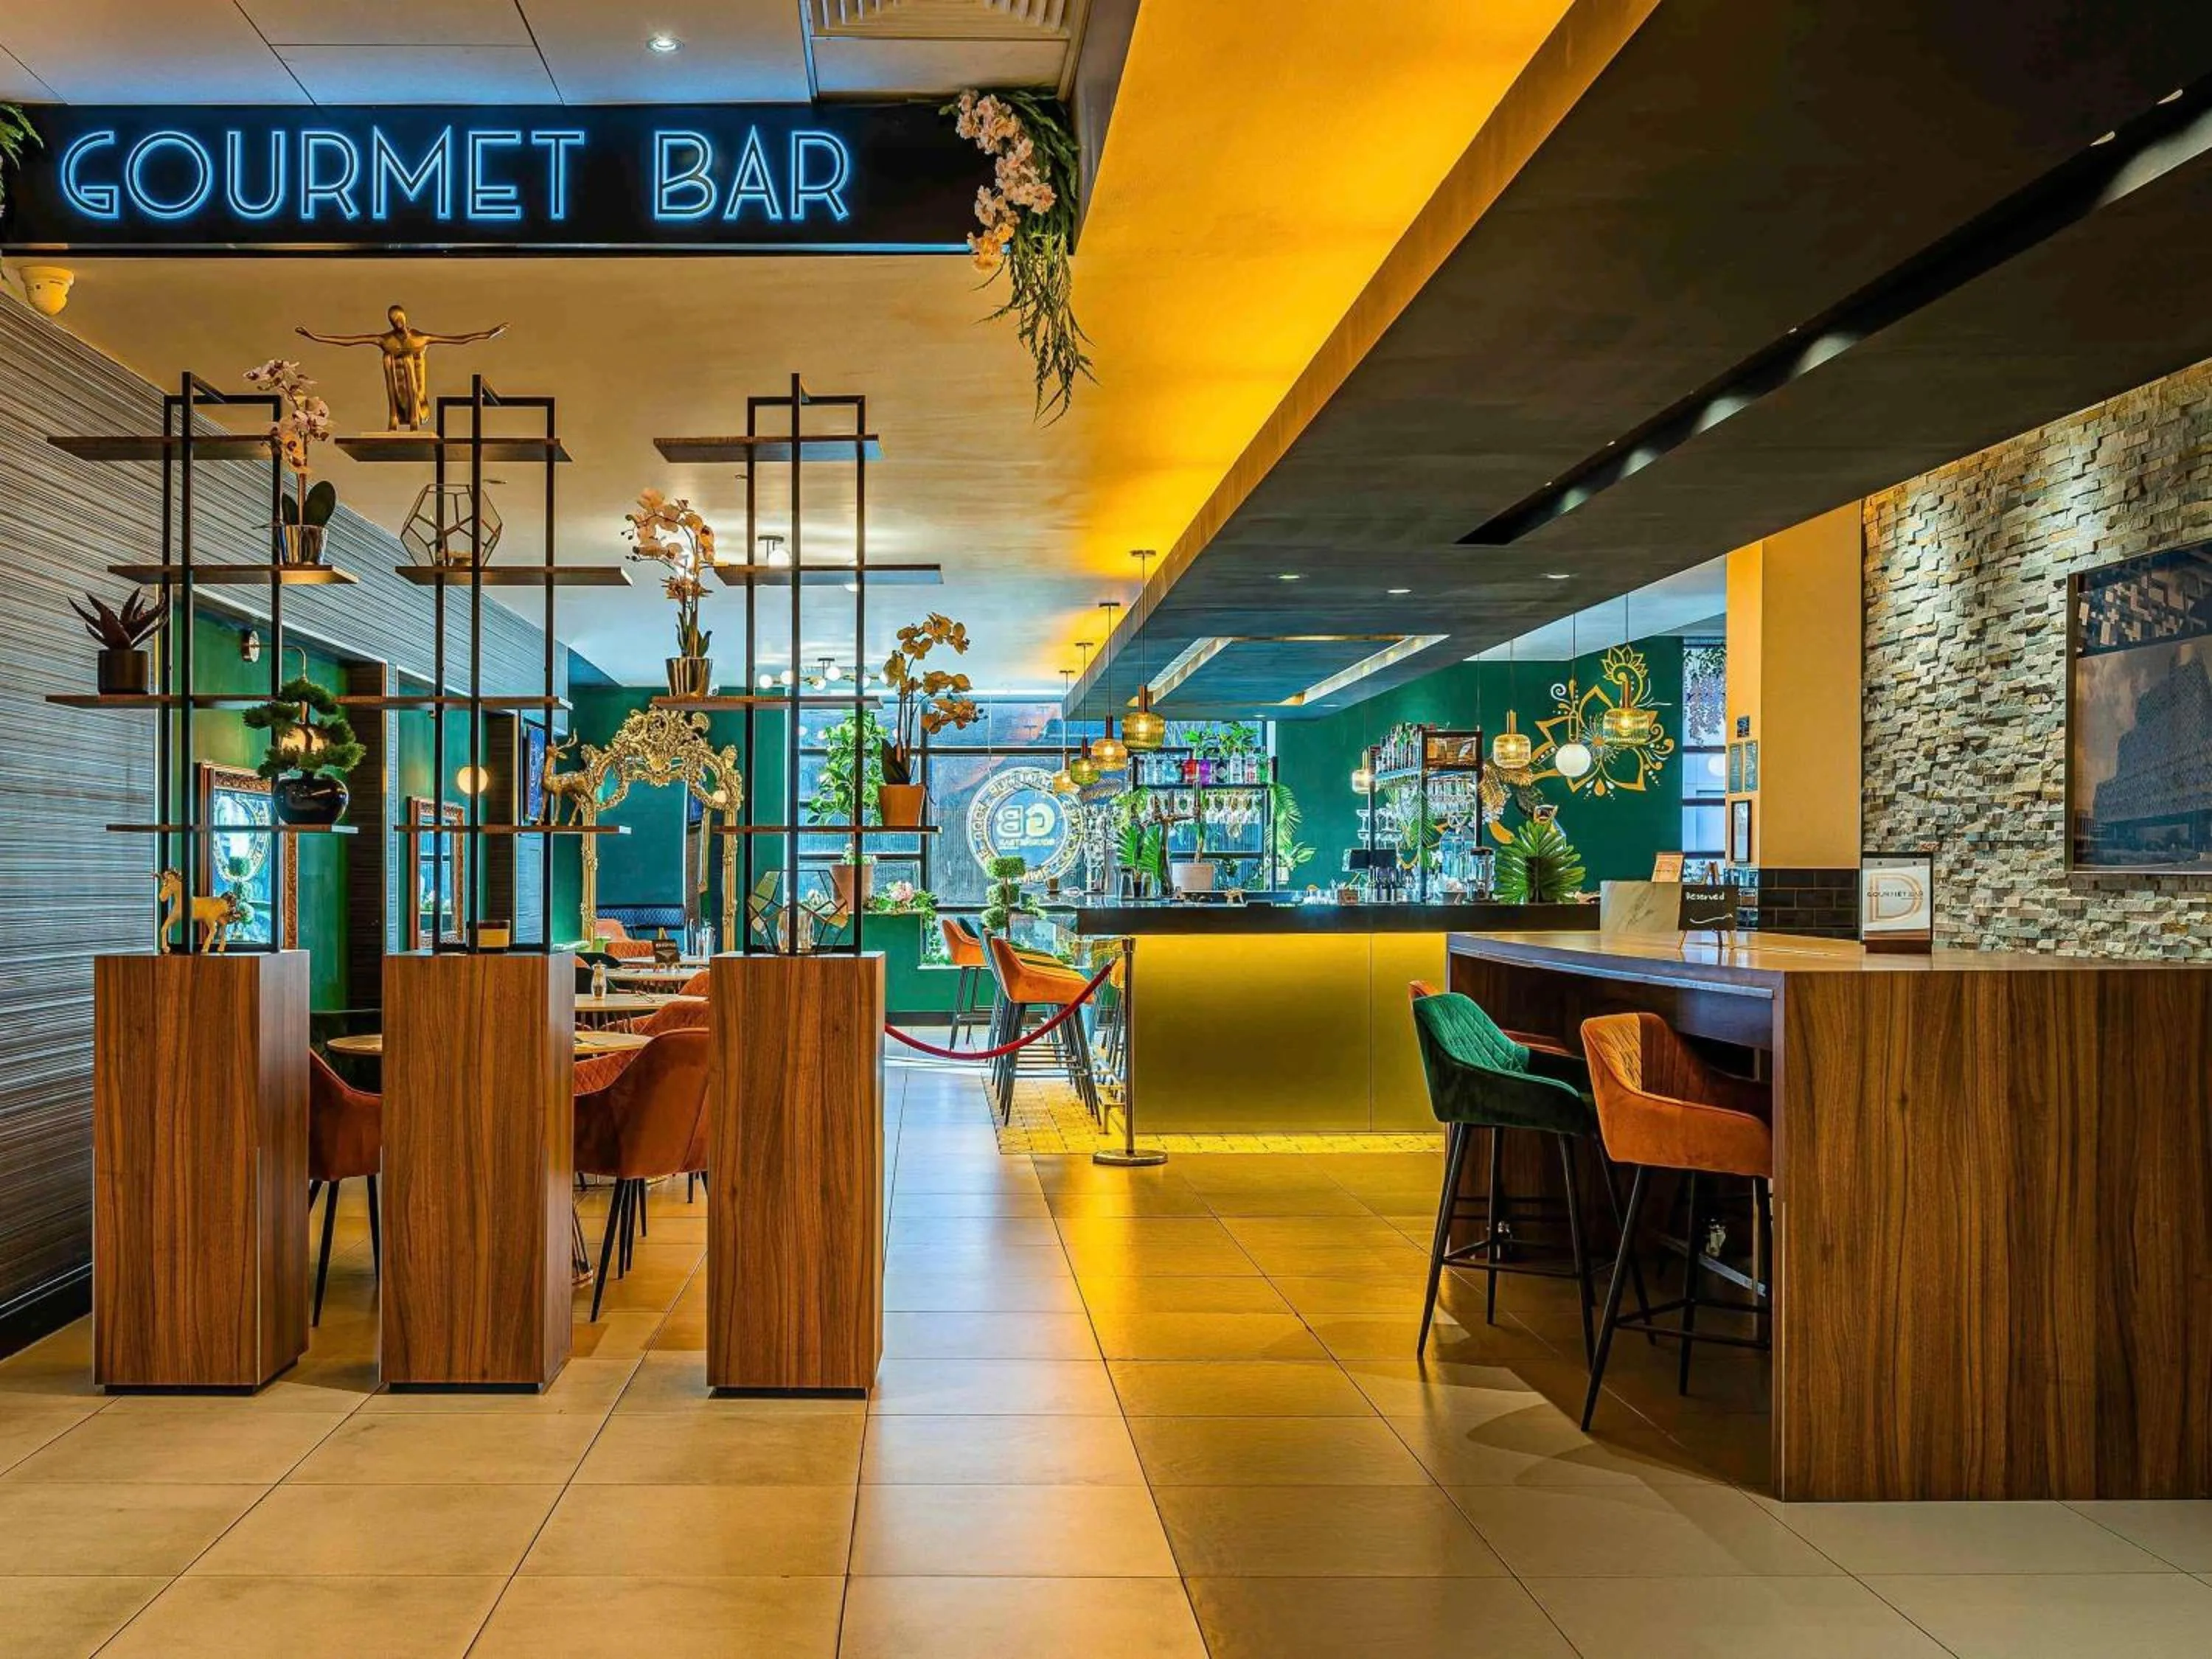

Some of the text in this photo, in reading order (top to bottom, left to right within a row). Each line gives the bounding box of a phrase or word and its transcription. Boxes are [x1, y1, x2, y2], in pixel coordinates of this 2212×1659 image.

[61, 125, 849, 220] GOURMET BAR
[1686, 891, 1725, 900] Reserved
